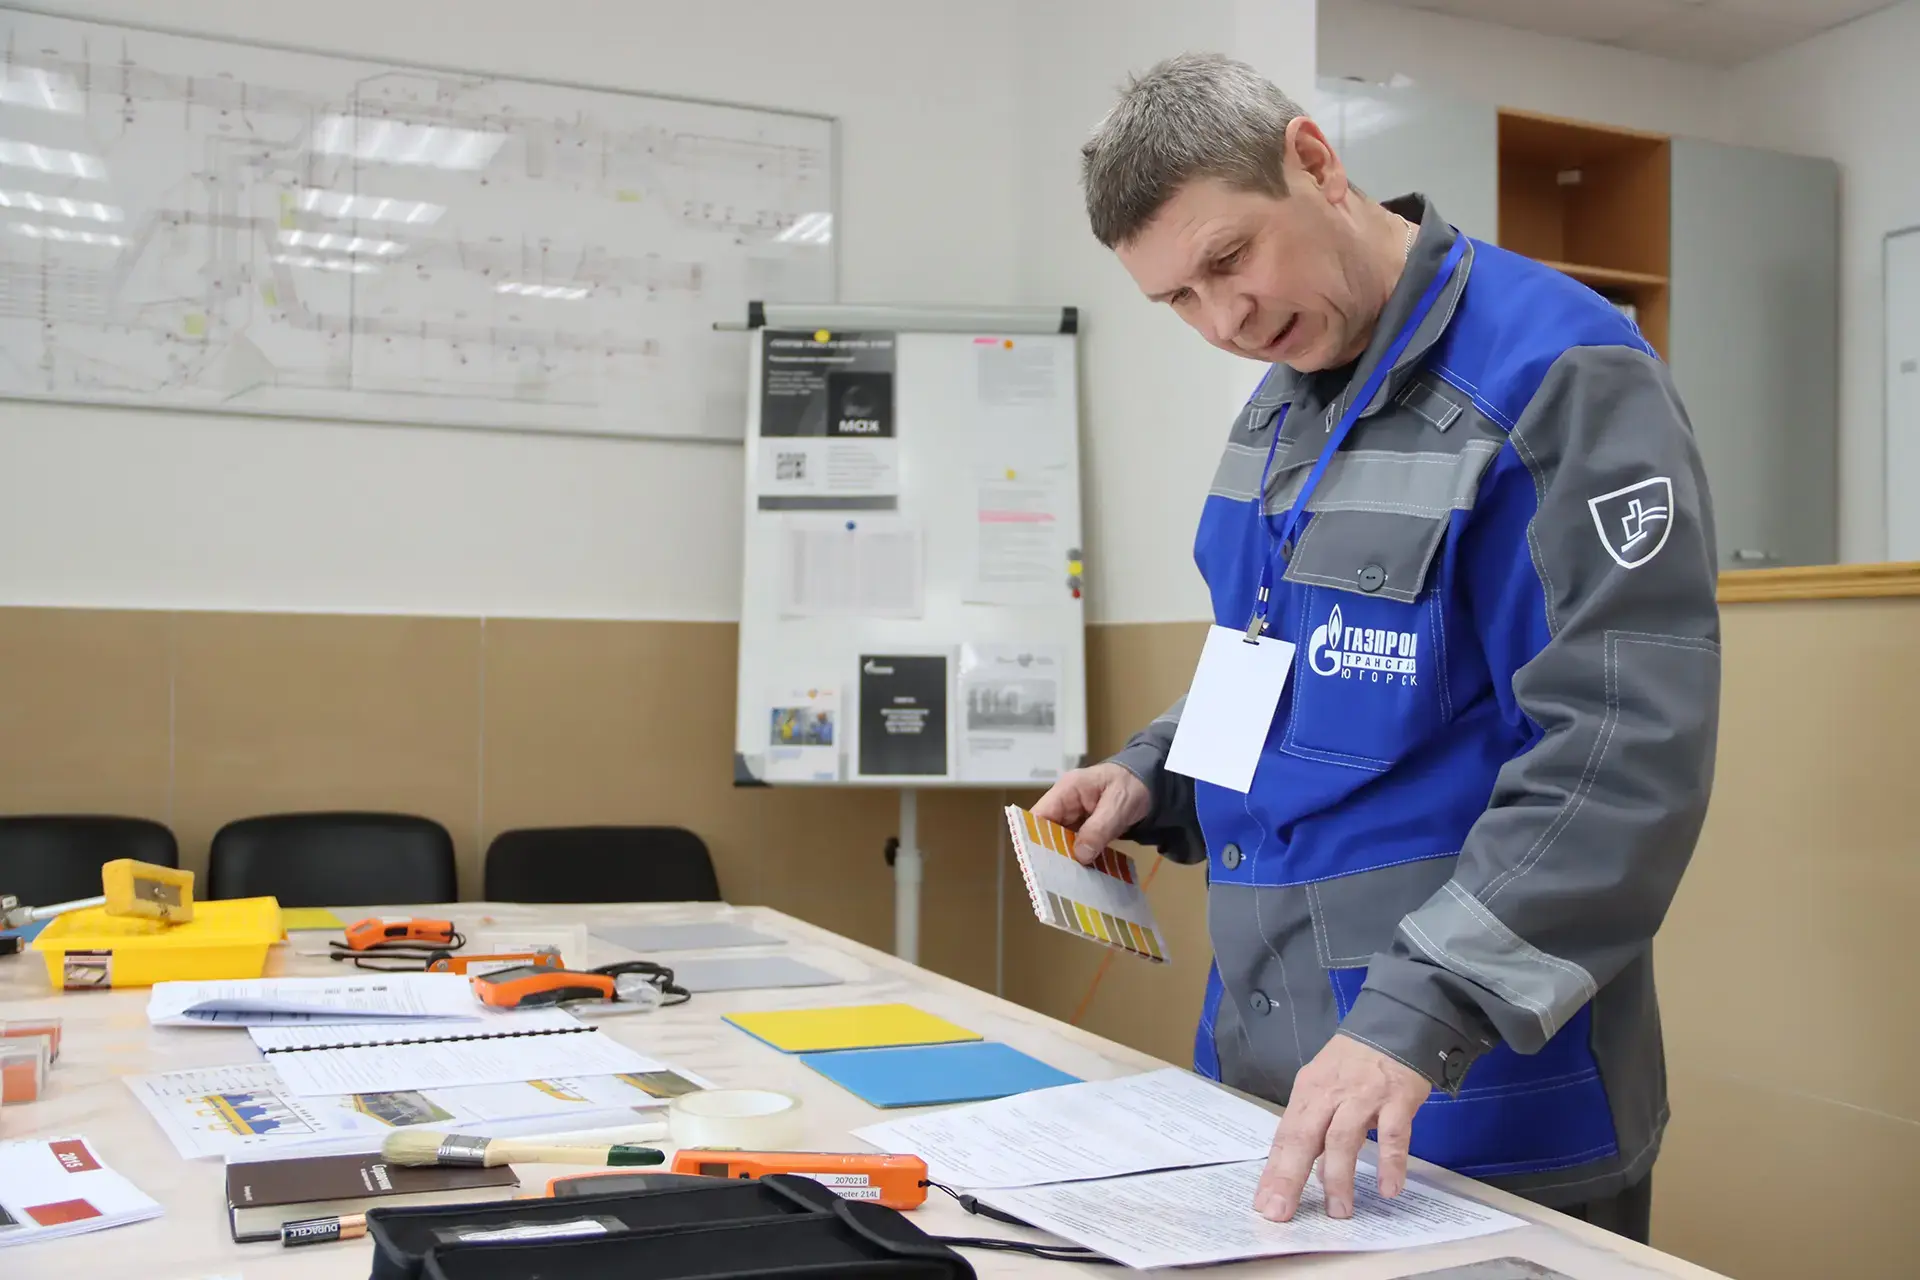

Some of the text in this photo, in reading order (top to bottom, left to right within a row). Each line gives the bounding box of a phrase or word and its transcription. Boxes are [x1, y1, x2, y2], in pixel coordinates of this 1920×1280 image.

[1341, 668, 1418, 686] ЮГОРСК
[58, 1152, 84, 1168] 2015
[834, 1176, 868, 1185] 2070218
[290, 1223, 338, 1237] DURACELL
